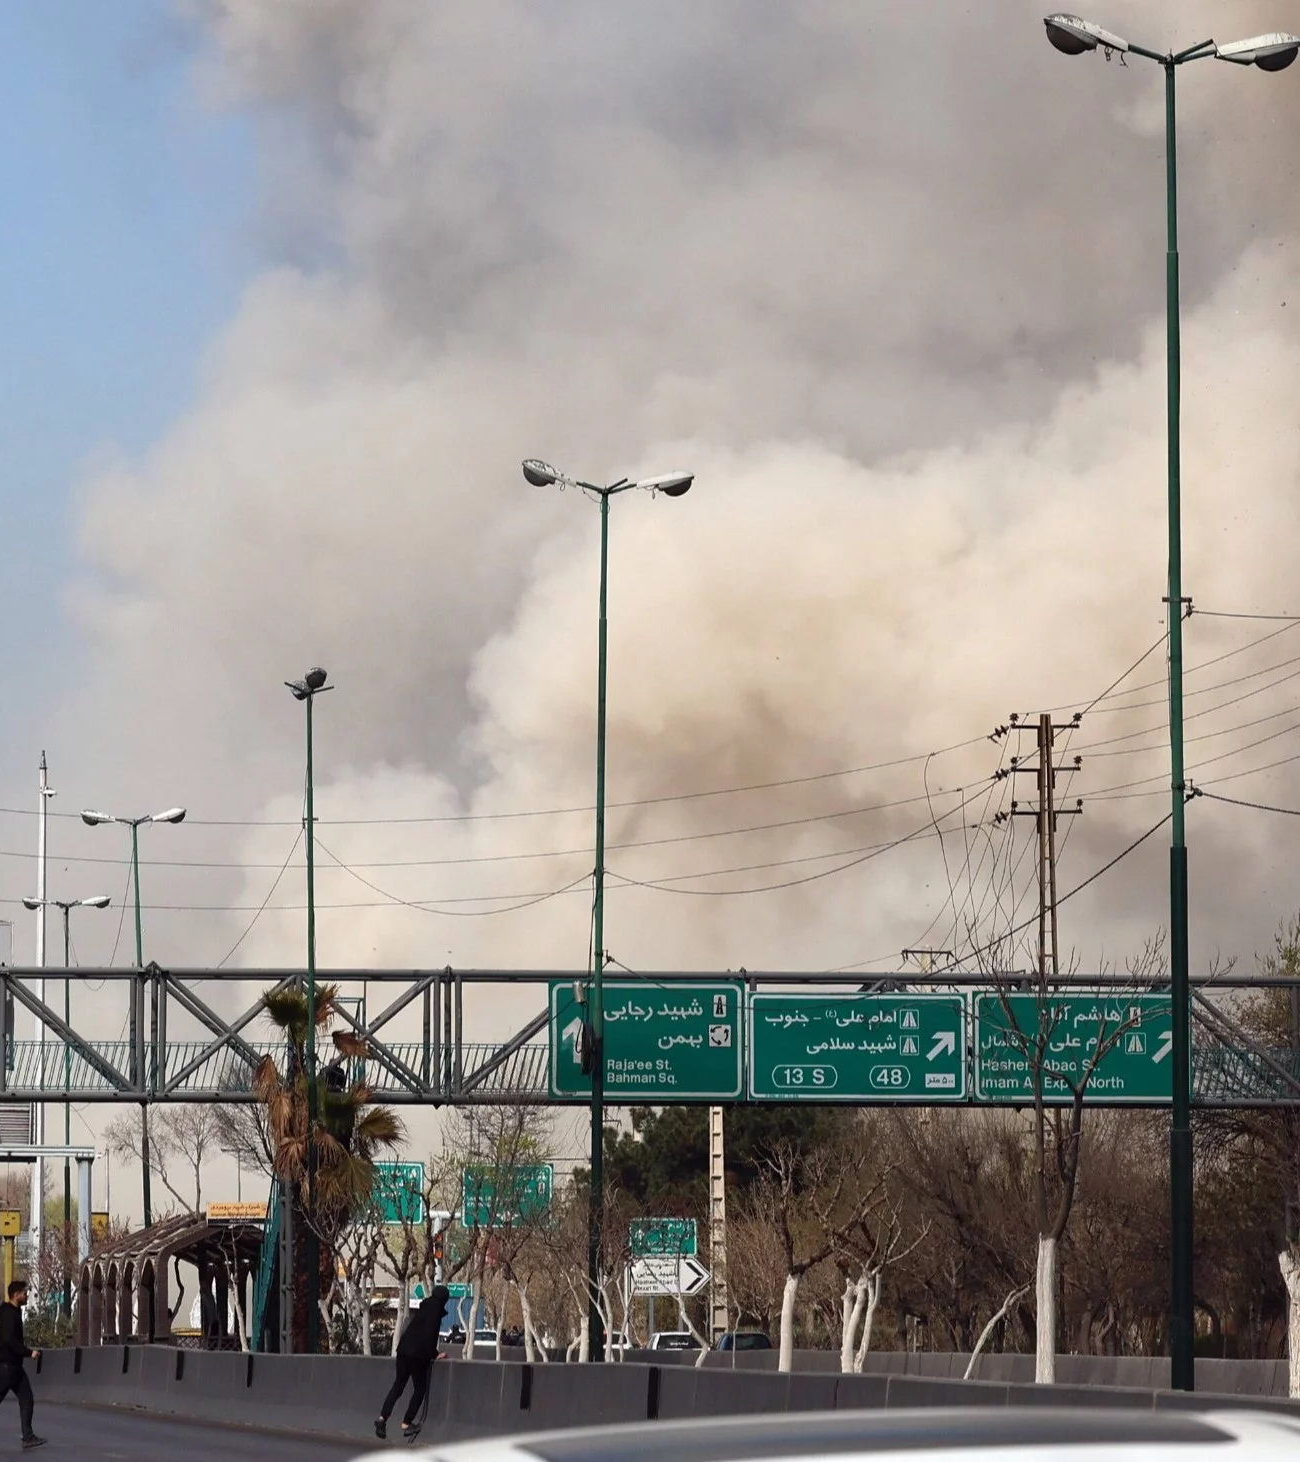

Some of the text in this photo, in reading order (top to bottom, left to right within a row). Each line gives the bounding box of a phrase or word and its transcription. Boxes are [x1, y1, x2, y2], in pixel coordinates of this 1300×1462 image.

[603, 998, 703, 1021] شهید رجایی
[1073, 1005, 1121, 1029] هاشم
[765, 1010, 809, 1029] جنوب
[868, 1010, 897, 1031] امام
[658, 1032, 703, 1049] بهمن
[805, 1035, 897, 1055] شهید سلامی
[1085, 1034, 1121, 1051] ام
[607, 1059, 672, 1071] Raja'ee St.
[981, 1058, 1030, 1071] Hashe
[1082, 1059, 1101, 1071] S.
[607, 1072, 678, 1085] Bahman Sq.
[783, 1068, 825, 1085] 13 S
[876, 1068, 903, 1085] 48
[927, 1076, 941, 1085] متر
[981, 1076, 1019, 1088] Imam
[1086, 1076, 1124, 1088] North
